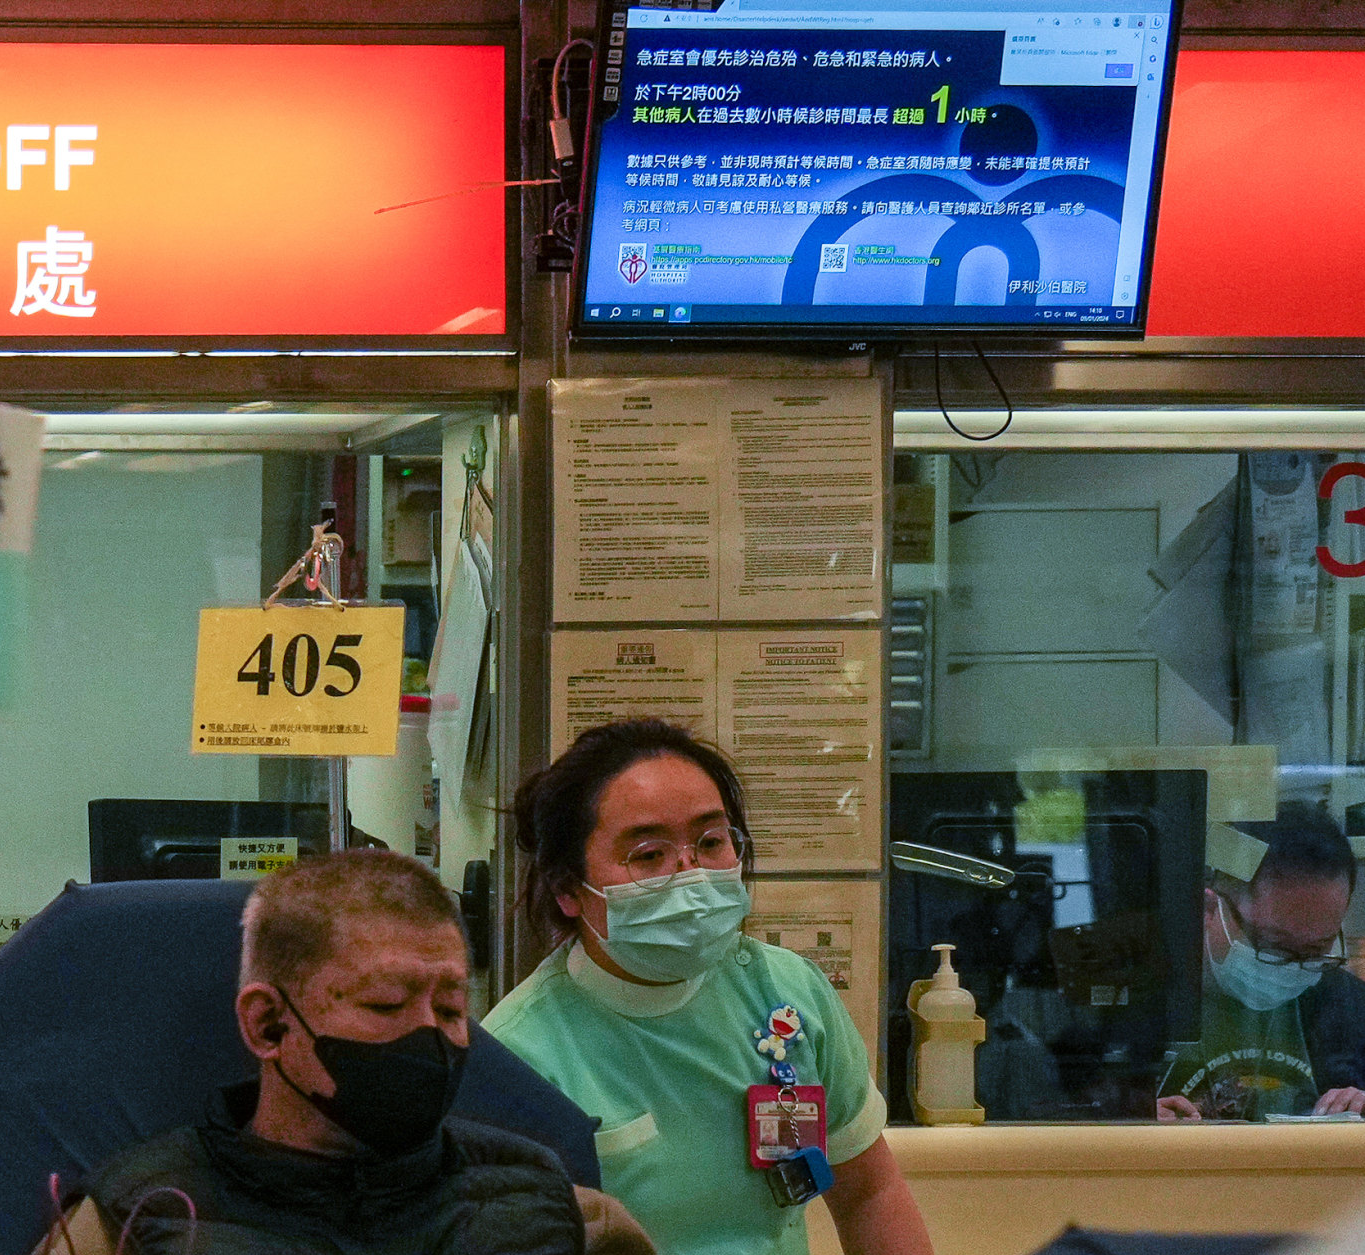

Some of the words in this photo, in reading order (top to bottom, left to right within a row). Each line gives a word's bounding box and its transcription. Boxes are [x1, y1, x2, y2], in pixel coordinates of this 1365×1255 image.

[633, 84, 742, 102] 於下午2時00分
[893, 108, 925, 125] 超過
[930, 85, 951, 123] 1
[1008, 280, 1088, 294] 伊利沙伯醫院
[848, 342, 867, 351] JVC
[1315, 461, 1365, 578] 3
[236, 632, 363, 698] 405
[238, 843, 285, 854] 快捷又方便
